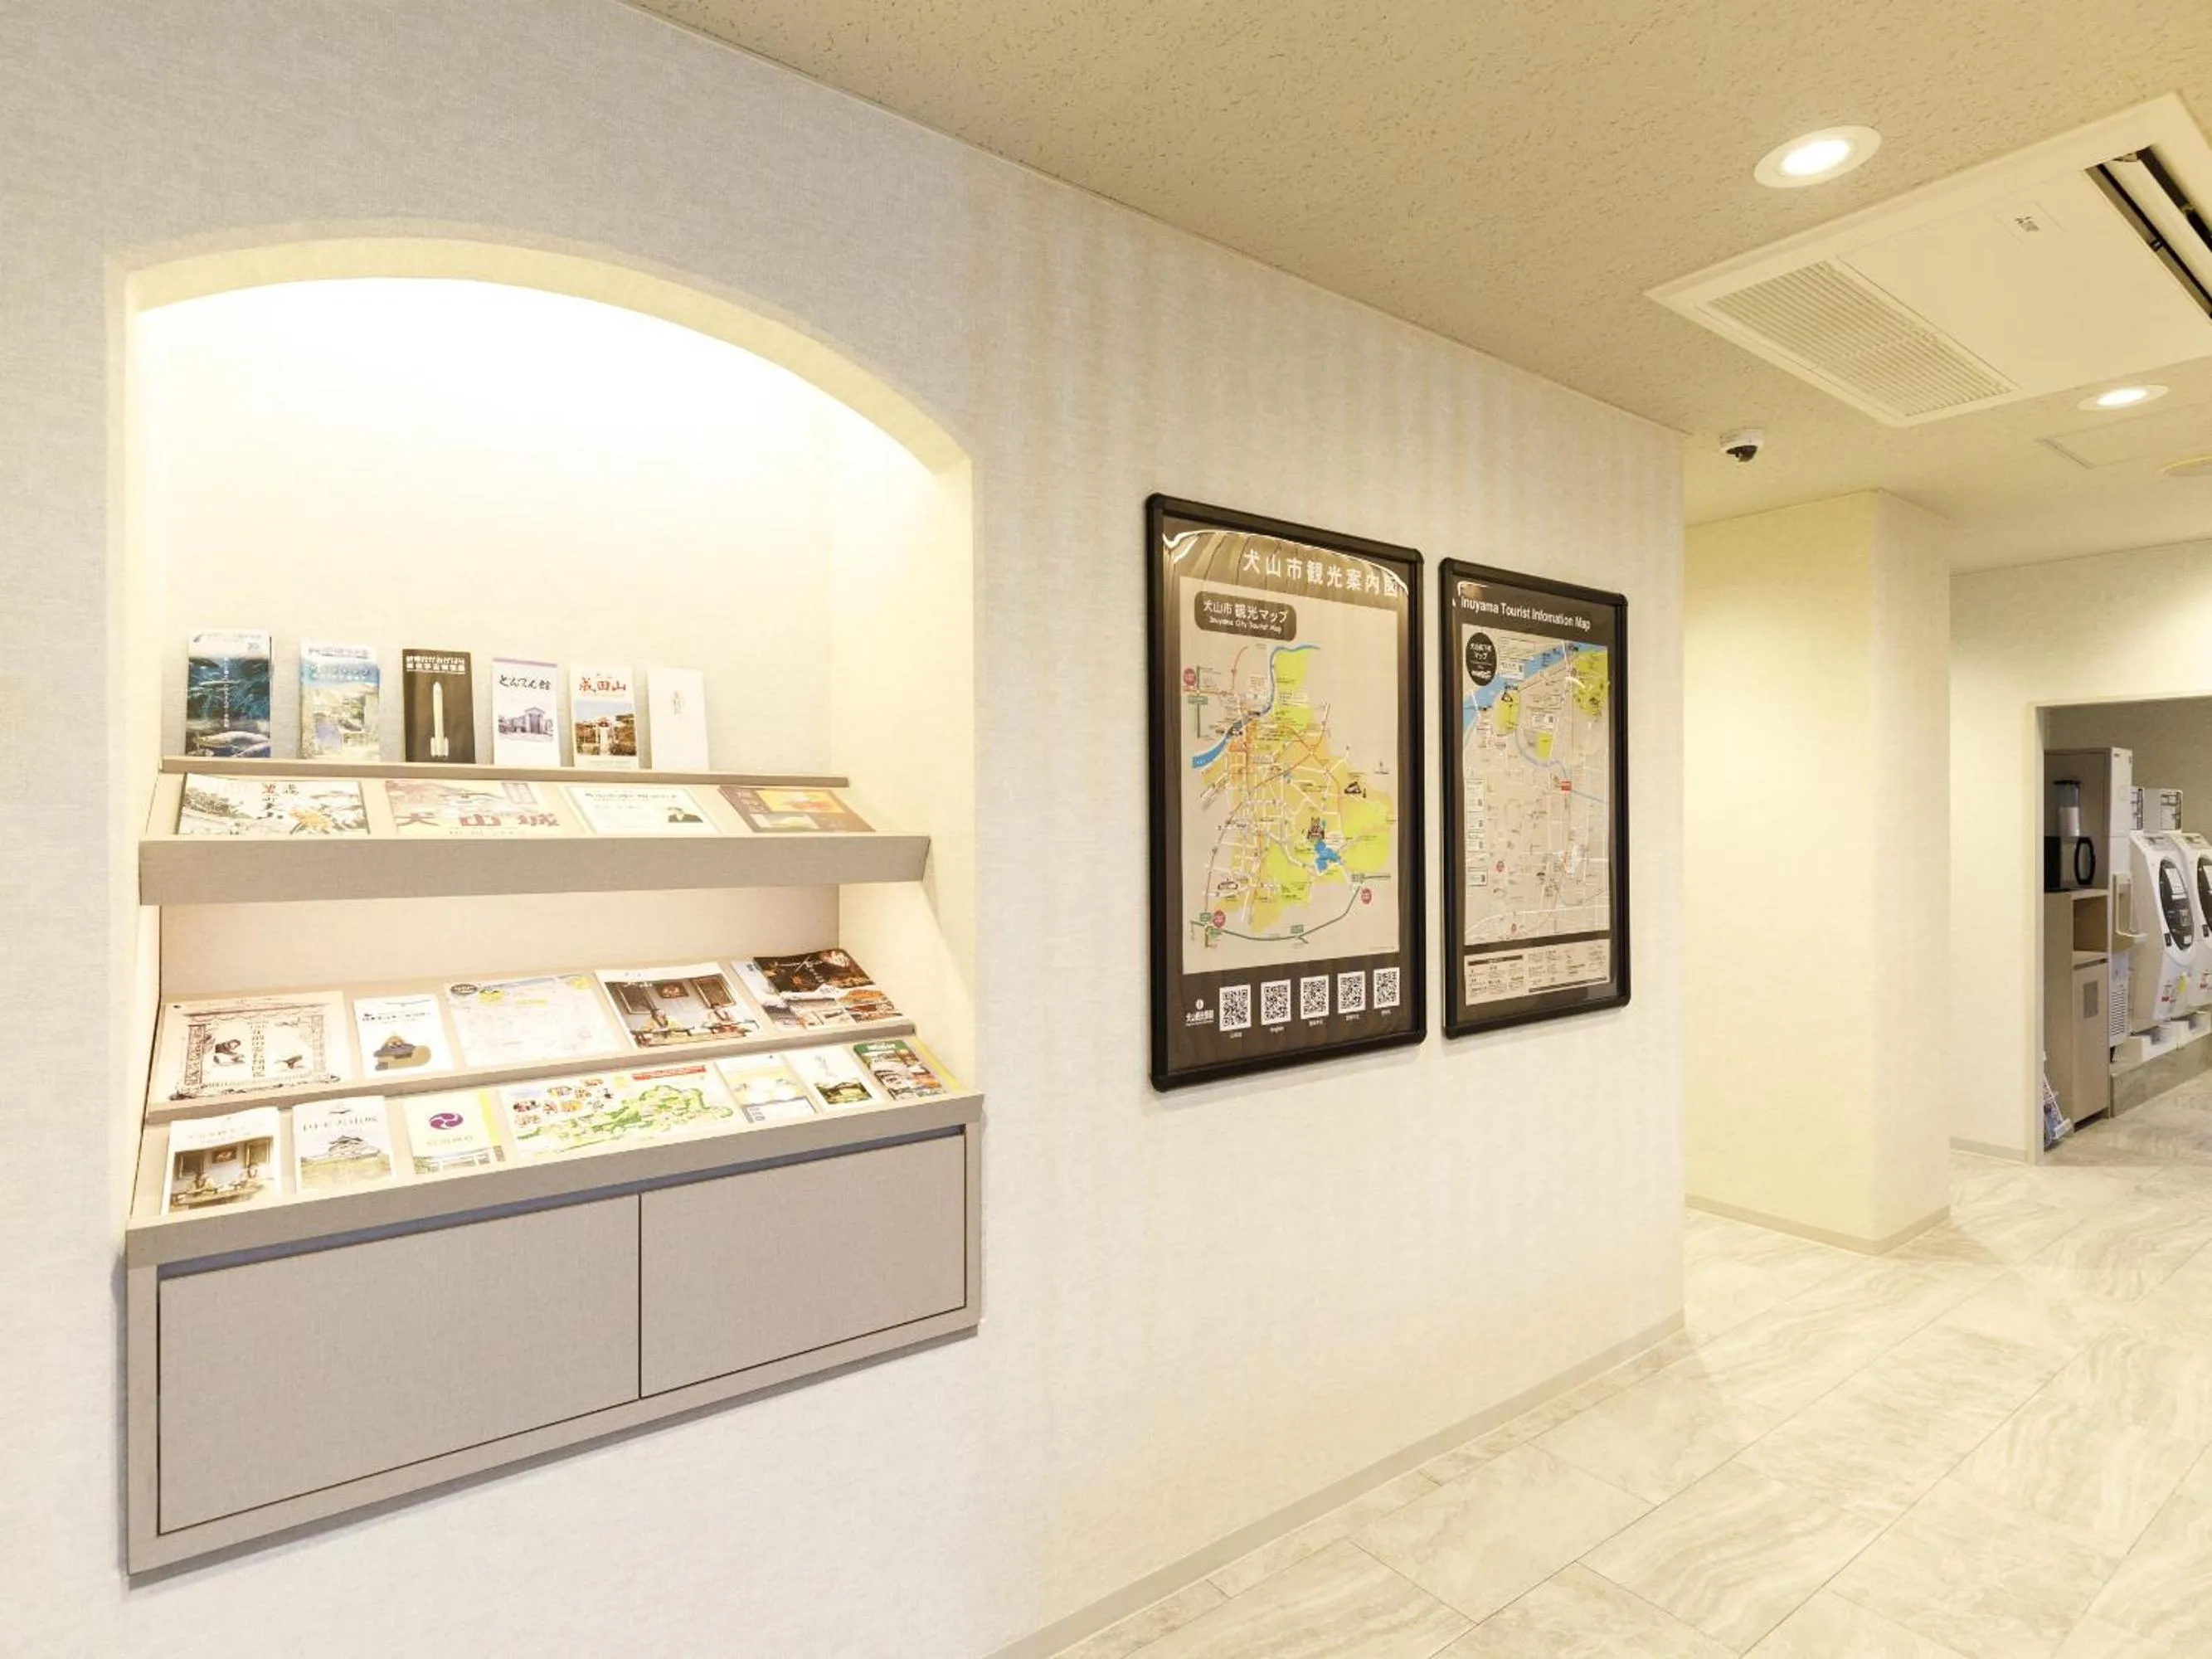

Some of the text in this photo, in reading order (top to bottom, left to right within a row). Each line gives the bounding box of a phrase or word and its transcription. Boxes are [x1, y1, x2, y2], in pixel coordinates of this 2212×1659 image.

[1461, 596, 1500, 615] Inuyama
[1500, 602, 1531, 620] Tourist
[1575, 616, 1592, 631] Map
